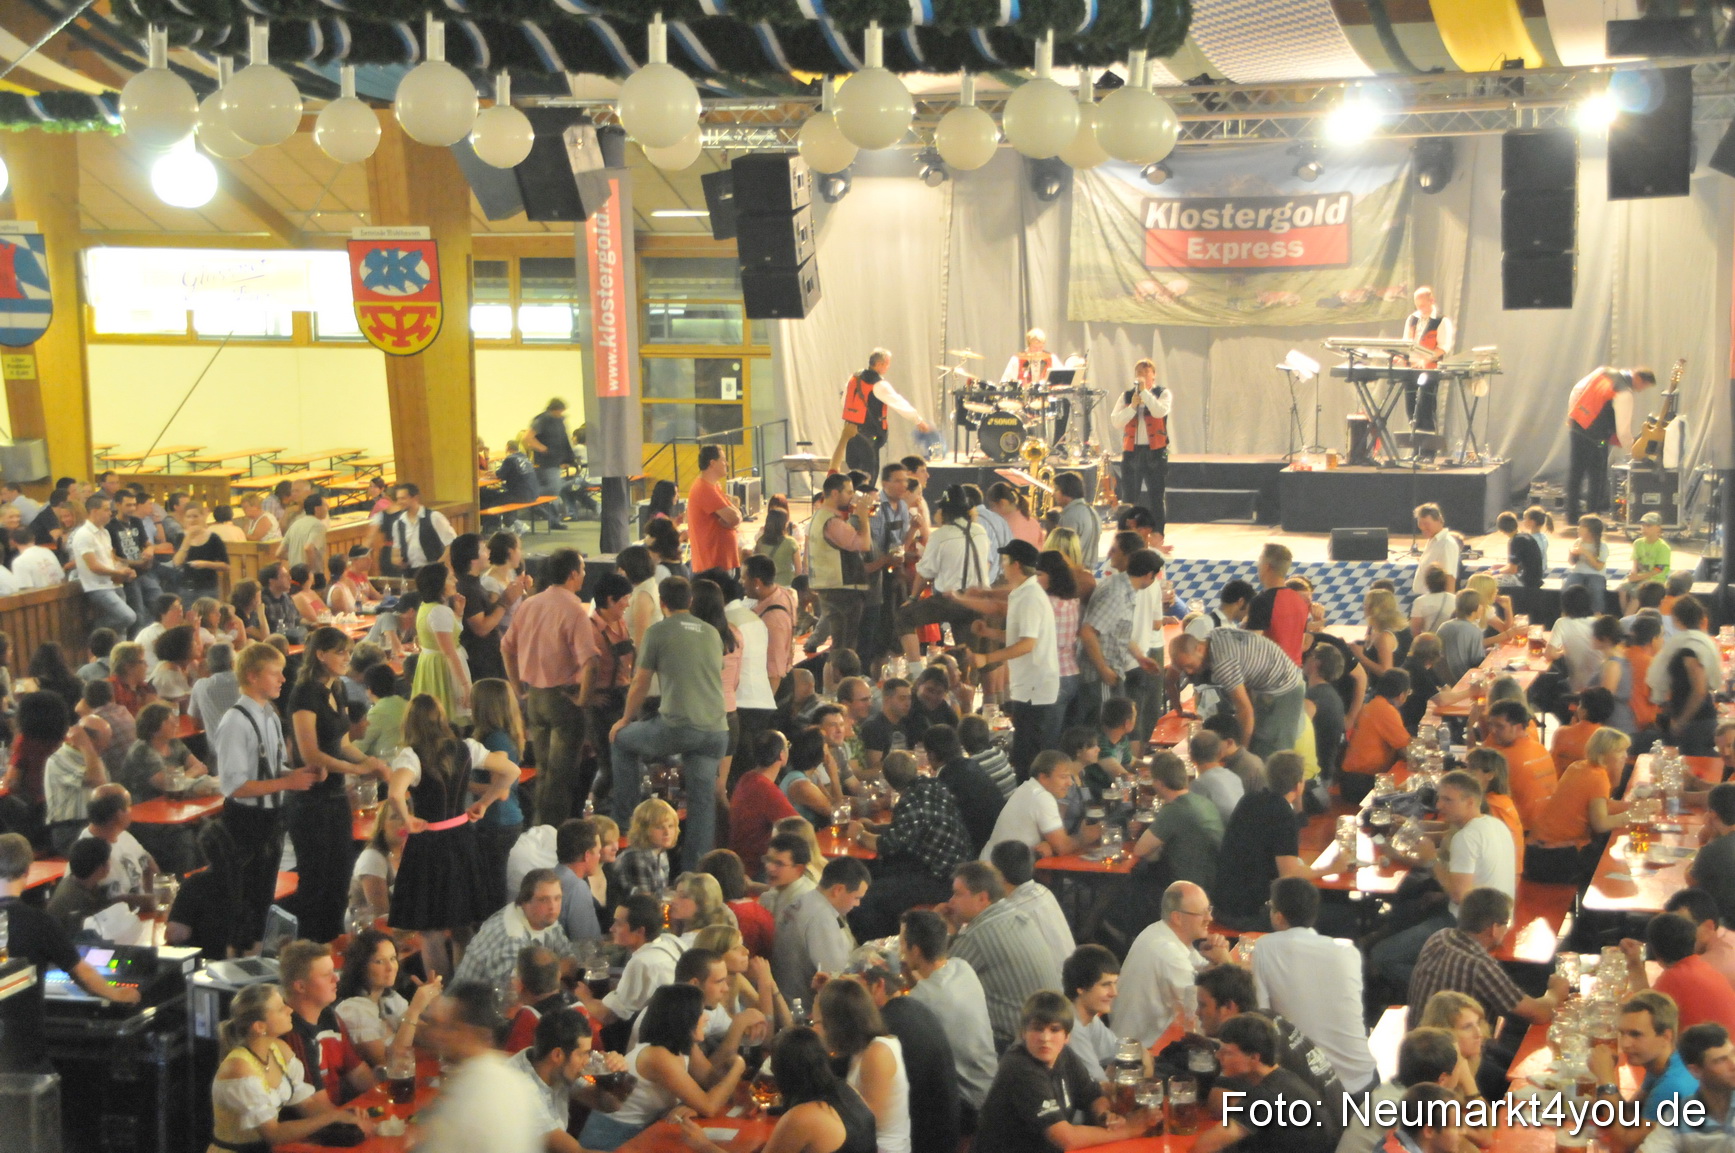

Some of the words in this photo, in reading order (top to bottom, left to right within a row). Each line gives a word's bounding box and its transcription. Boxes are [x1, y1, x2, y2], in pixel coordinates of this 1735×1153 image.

[1145, 196, 1349, 234] Klostergold
[1187, 237, 1305, 264] Express
[593, 200, 619, 391] www.klostergold.
[993, 417, 1018, 425] SONOR
